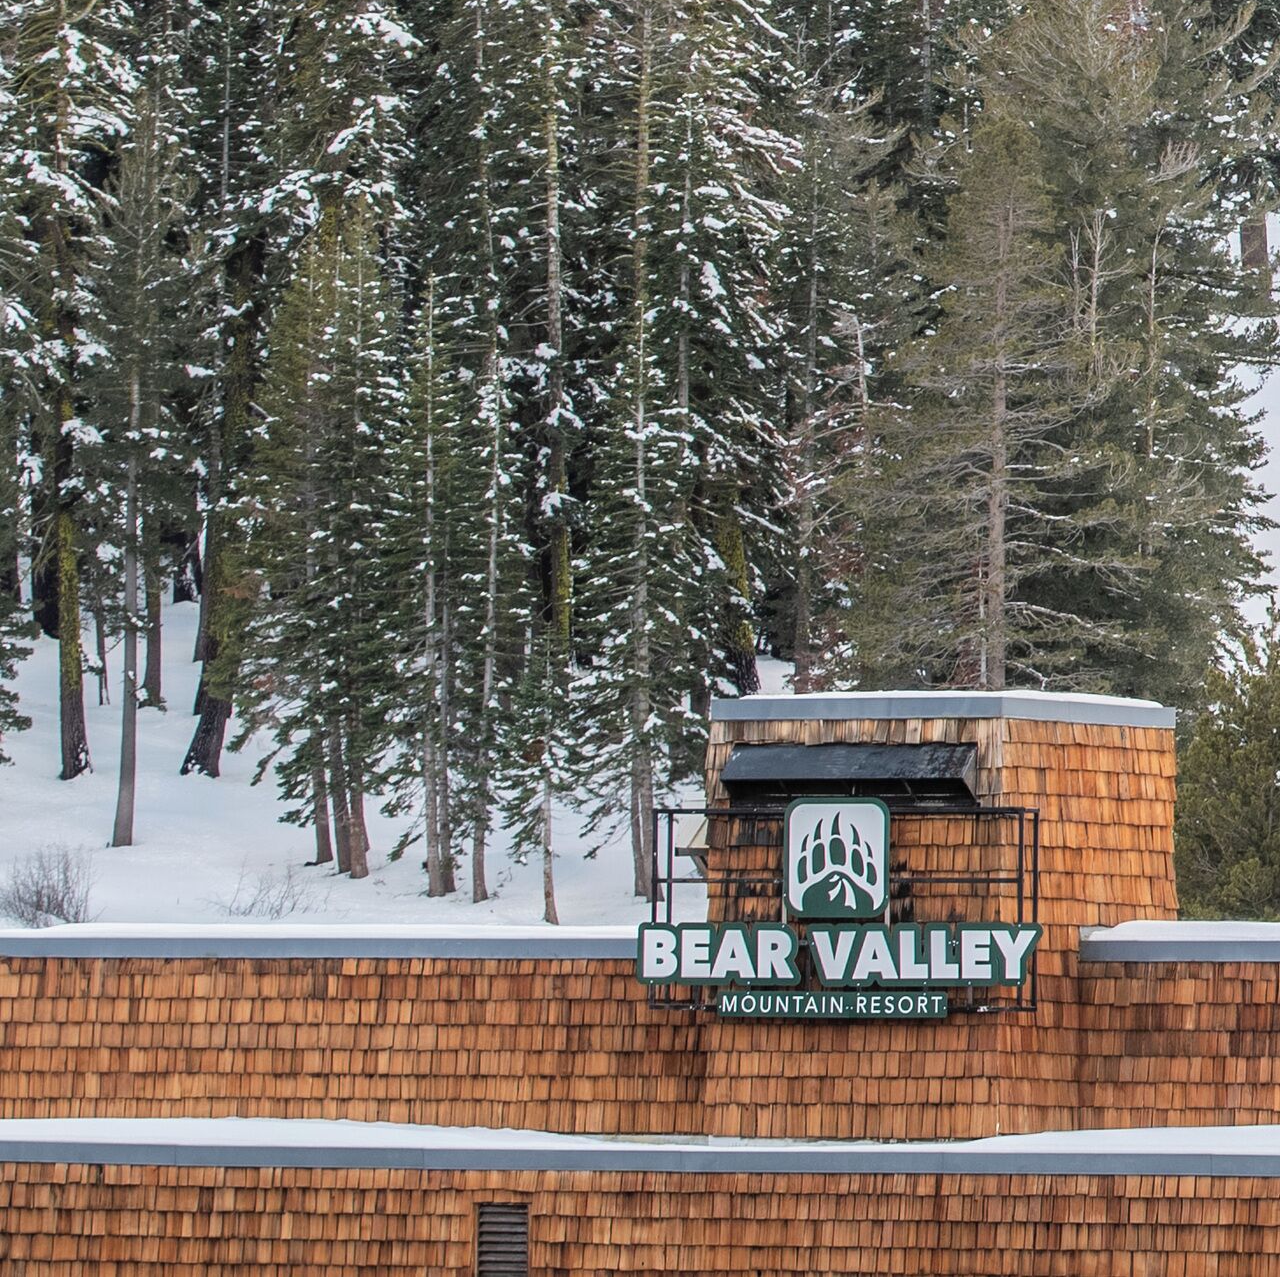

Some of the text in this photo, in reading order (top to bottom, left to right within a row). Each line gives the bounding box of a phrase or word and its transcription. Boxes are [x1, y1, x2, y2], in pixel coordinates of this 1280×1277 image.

[643, 929, 1037, 980] BEAR VALLEY
[722, 995, 943, 1014] MOUNTAIN RESORT
